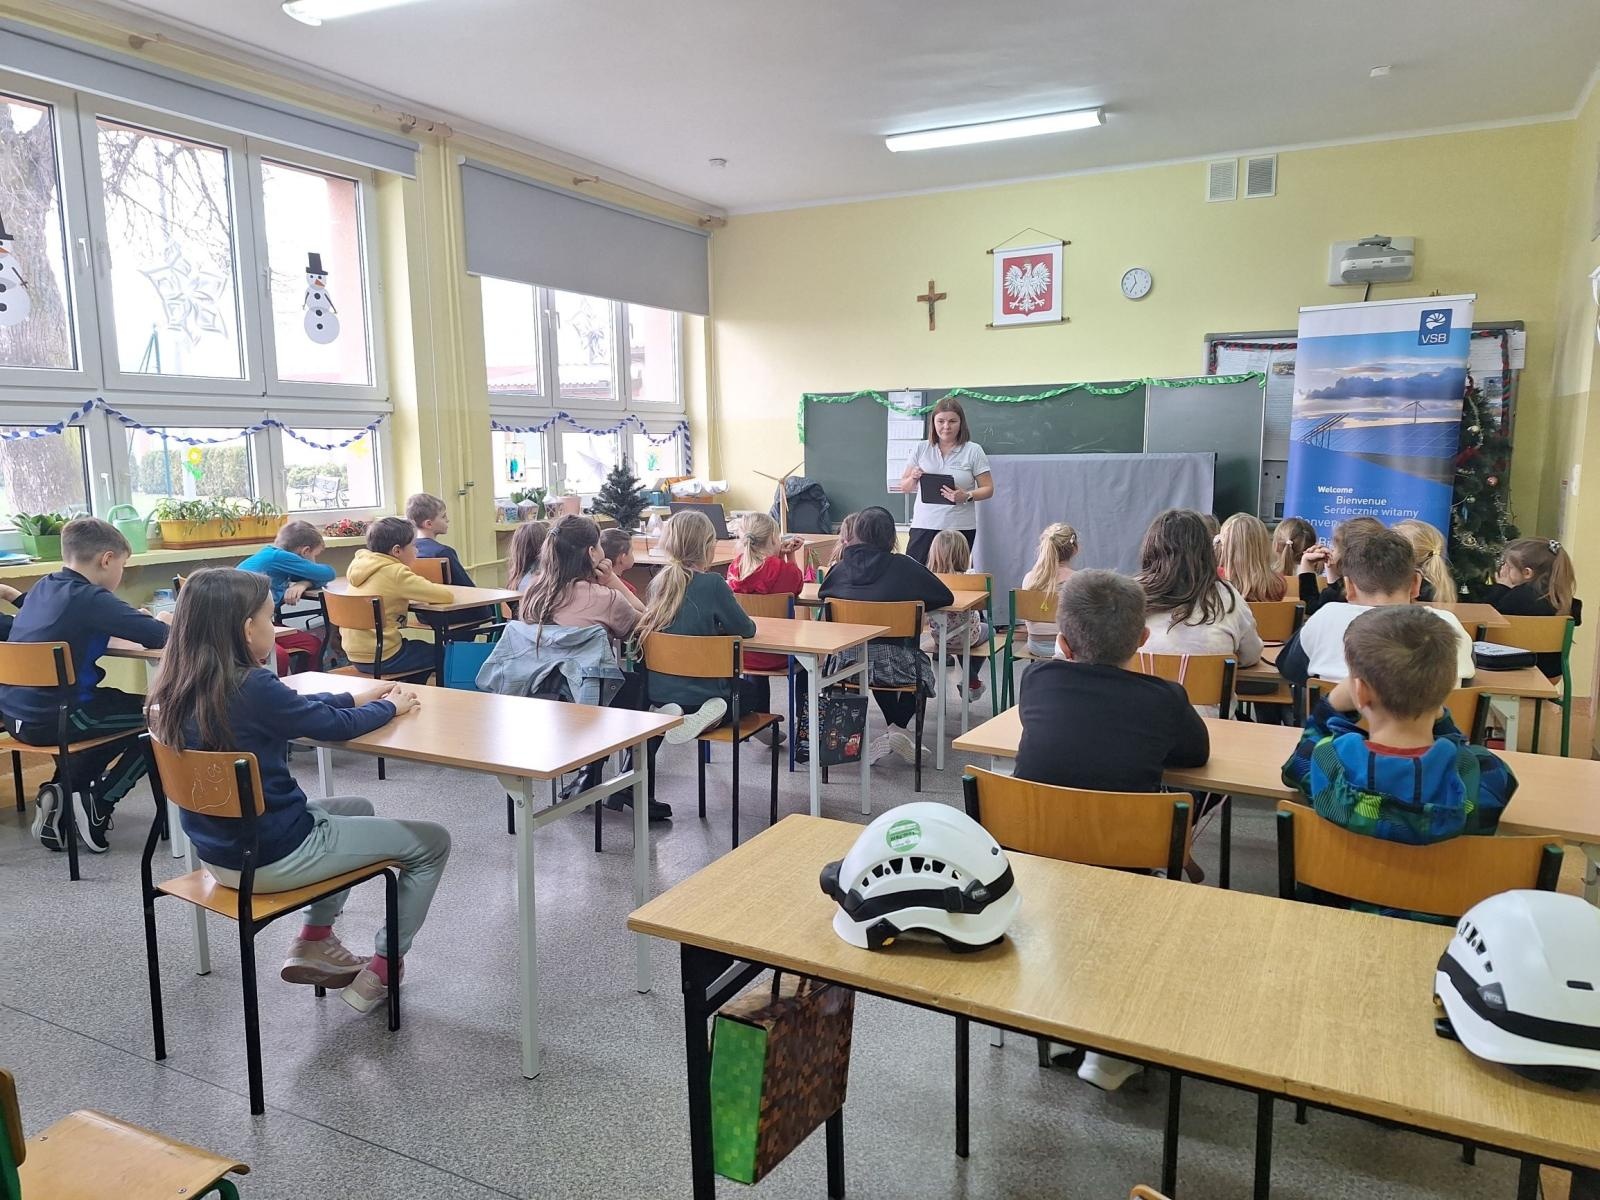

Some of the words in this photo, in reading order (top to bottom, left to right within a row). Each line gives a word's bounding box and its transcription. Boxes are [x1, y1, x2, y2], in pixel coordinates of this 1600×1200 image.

[1421, 333, 1447, 344] VSB
[1317, 485, 1354, 494] Welcome
[1336, 495, 1387, 506] Bienvenue
[1323, 505, 1379, 516] Serdecznie
[1381, 507, 1420, 519] witamy
